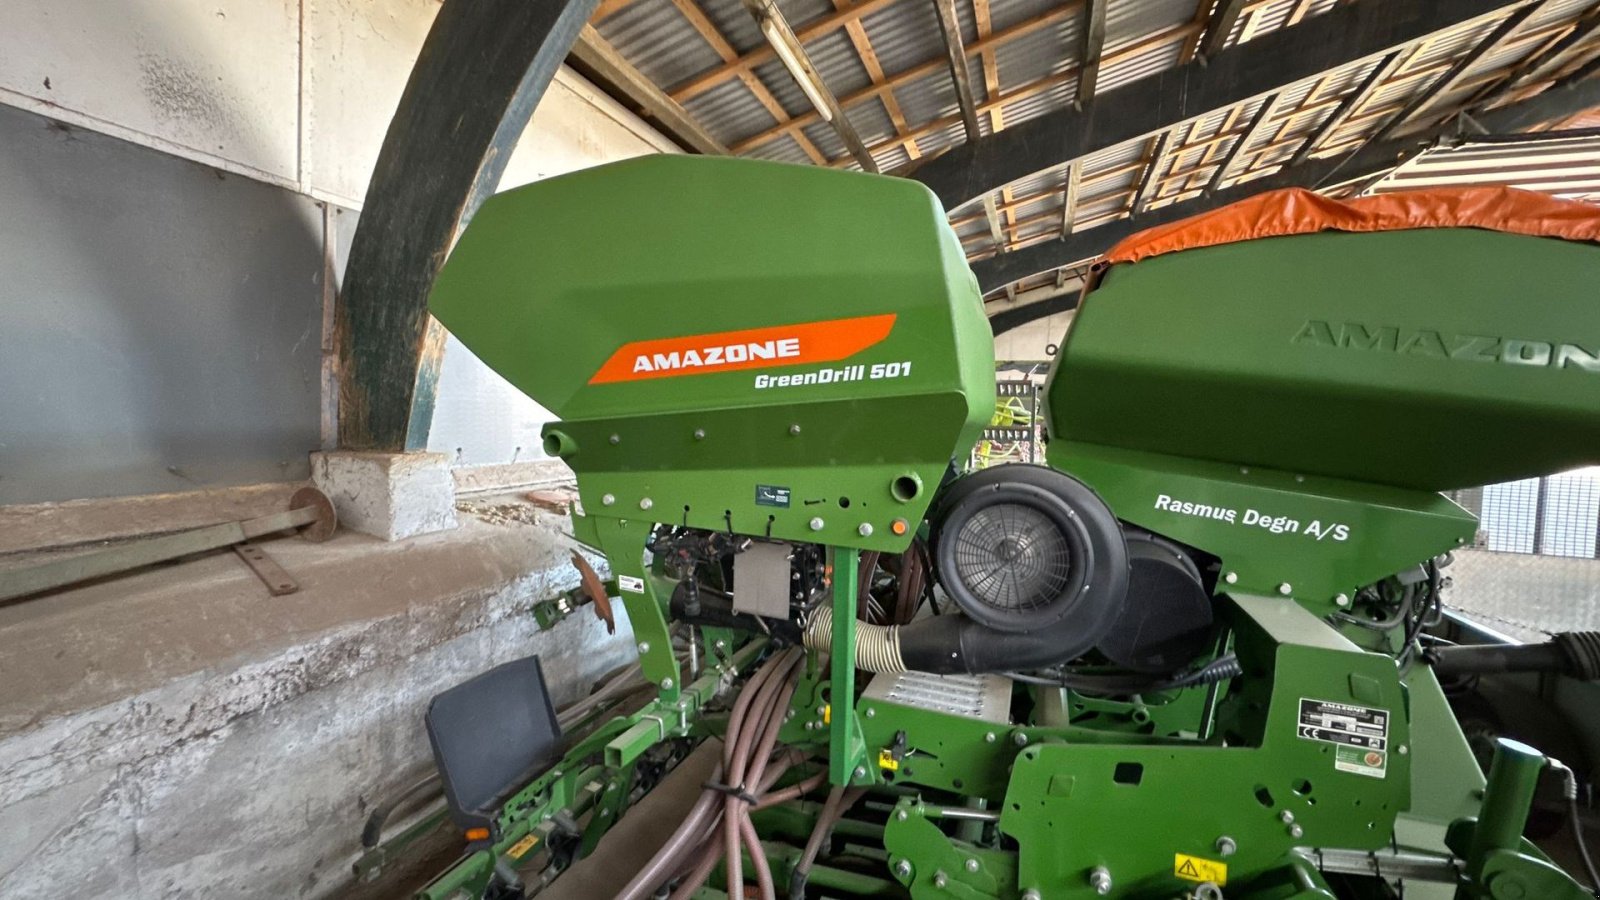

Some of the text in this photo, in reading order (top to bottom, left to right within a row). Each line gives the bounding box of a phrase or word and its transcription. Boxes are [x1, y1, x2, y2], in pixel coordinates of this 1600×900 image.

[632, 337, 801, 374] AMAZONE
[754, 361, 912, 390] GreenDrill 501
[1154, 494, 1350, 542] Rasmus Degn A/S
